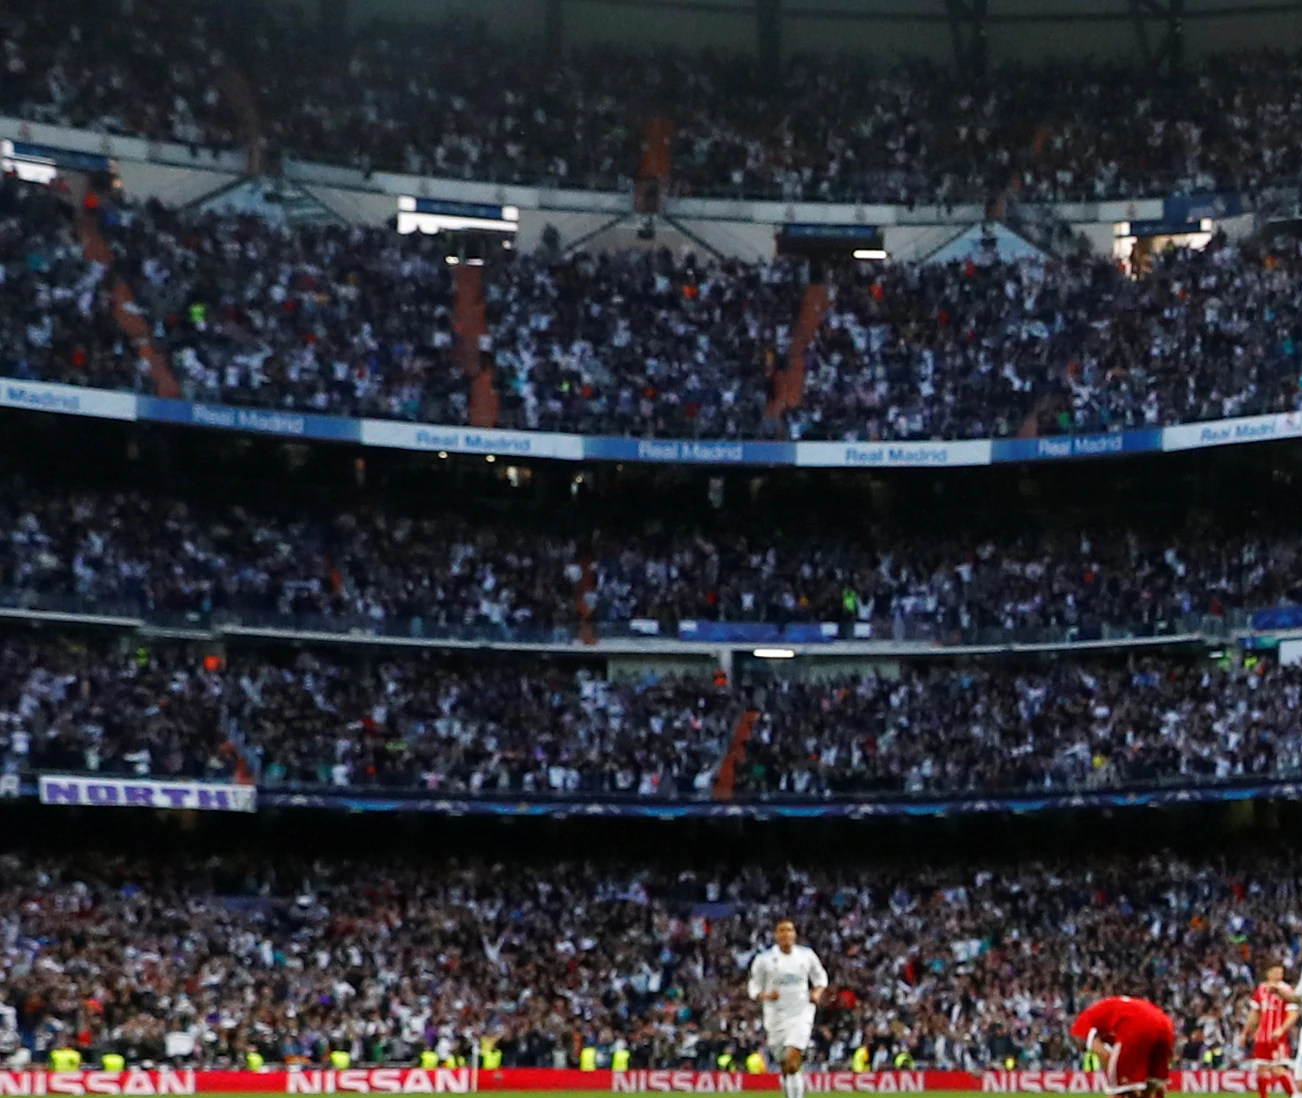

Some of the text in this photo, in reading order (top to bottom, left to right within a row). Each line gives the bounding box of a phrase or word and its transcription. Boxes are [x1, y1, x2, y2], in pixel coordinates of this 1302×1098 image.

[1201, 425, 1233, 441] Real
[846, 449, 947, 463] Real Madrid
[45, 783, 231, 808] NORTH
[0, 1069, 196, 1095] NISSAN
[286, 1067, 470, 1093] NISSAN
[612, 1070, 742, 1093] NISSAN
[803, 1071, 924, 1092] NISSAN
